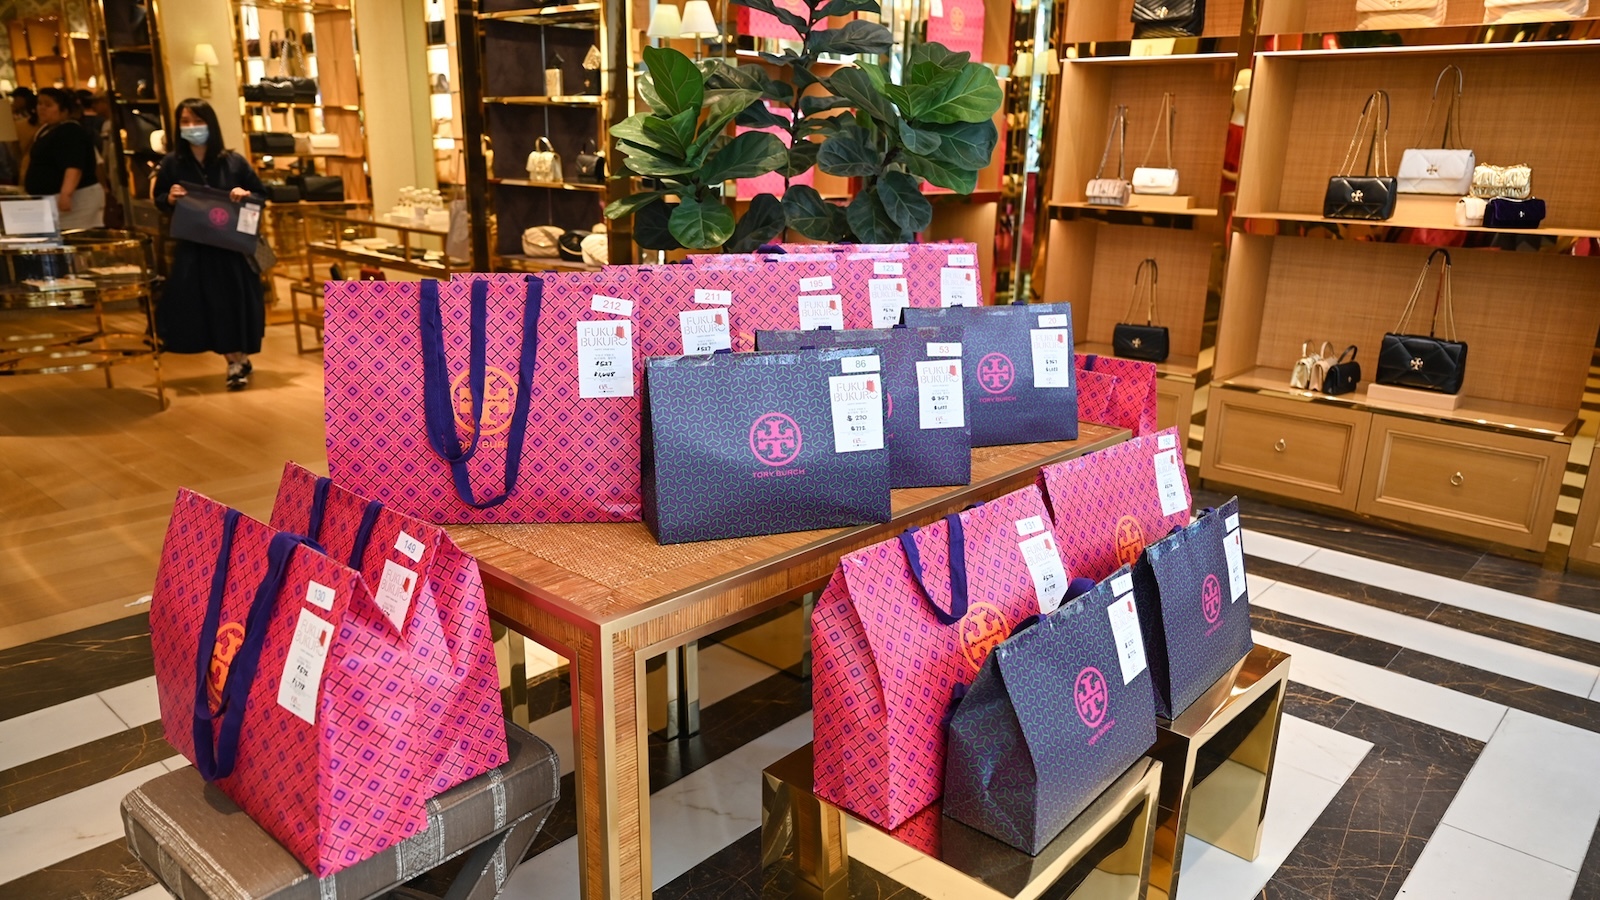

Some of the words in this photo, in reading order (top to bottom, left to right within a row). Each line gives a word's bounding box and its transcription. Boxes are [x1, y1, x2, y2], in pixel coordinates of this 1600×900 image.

[809, 279, 824, 288] 195
[704, 292, 720, 301] 211
[602, 300, 622, 311] 212
[804, 300, 829, 309] FUKU
[801, 308, 840, 317] BUKURO
[686, 315, 714, 326] FUKU
[584, 327, 616, 337] FUKU
[683, 323, 726, 335] BUKURO
[580, 336, 628, 347] BUKURO
[938, 345, 950, 354] 53
[855, 359, 866, 369] 86
[922, 365, 950, 375] FUKU
[920, 374, 959, 384] BUKURO
[836, 381, 866, 392] FUKU
[833, 391, 878, 402] BUKURO
[752, 471, 775, 479] TORY
[776, 468, 806, 477] BURCH
[1024, 520, 1036, 530] 131
[404, 540, 417, 554] 149
[385, 568, 405, 587] FUKU
[380, 578, 409, 602] BUKURO
[313, 589, 326, 603] 130
[300, 619, 321, 640] FUKU
[294, 628, 326, 657] BUKURO
